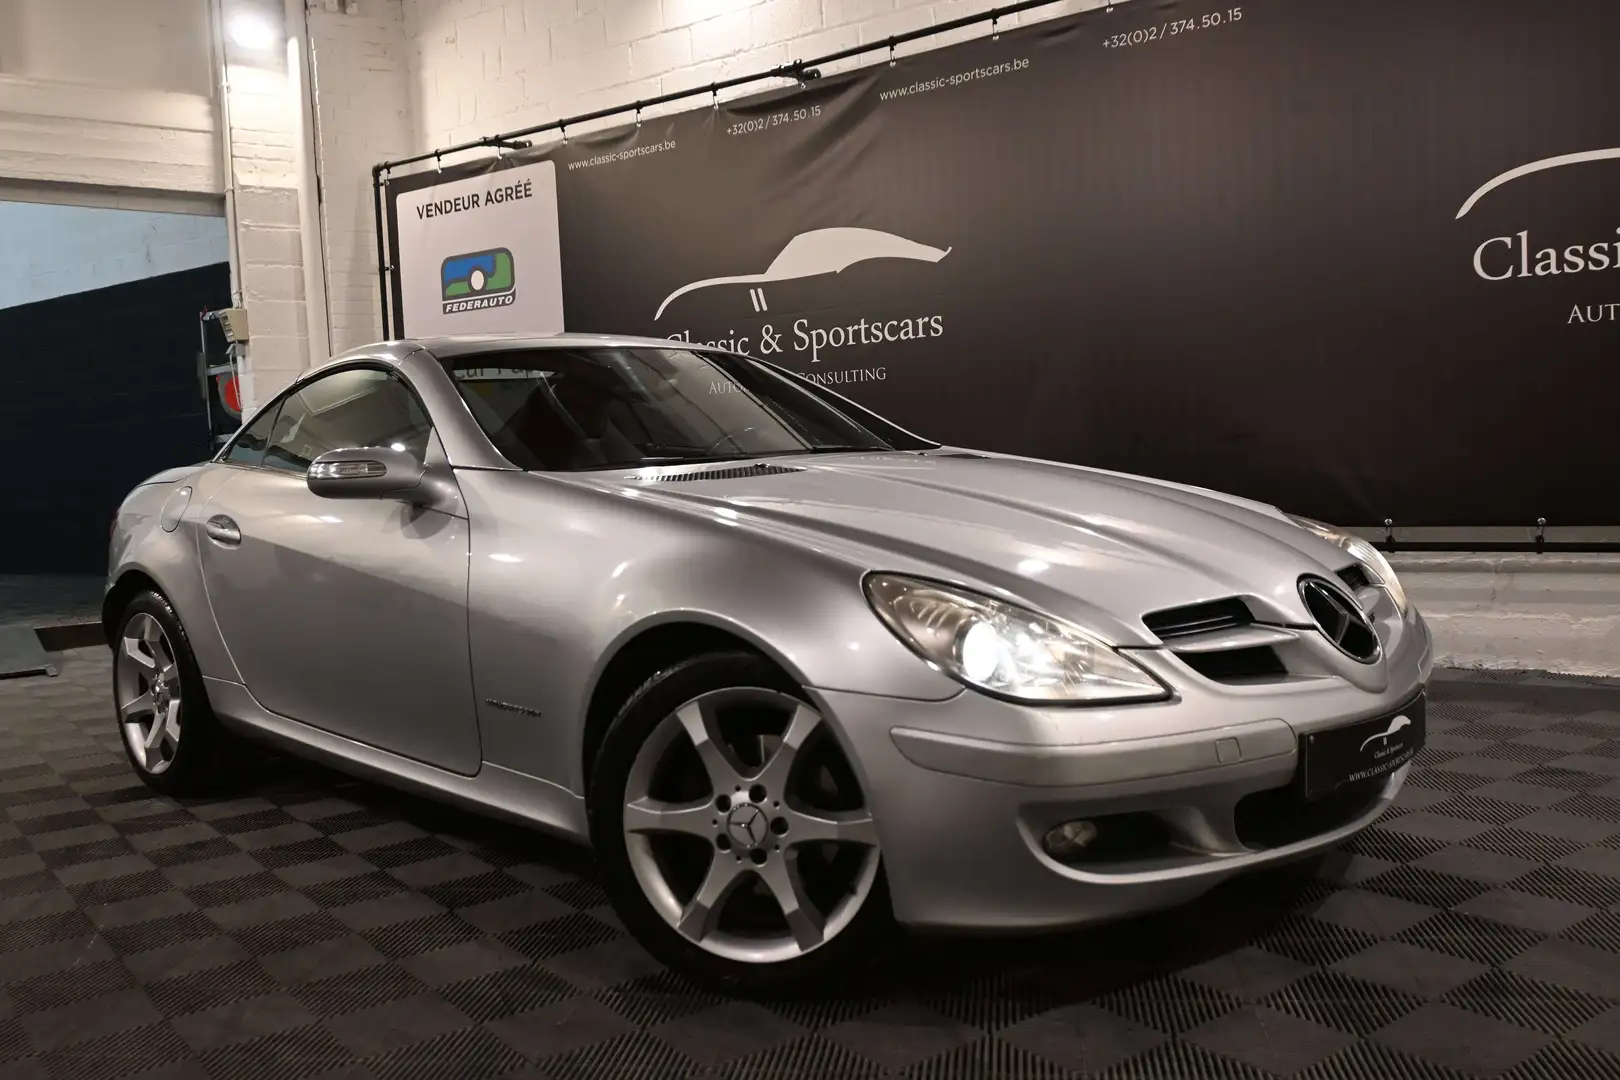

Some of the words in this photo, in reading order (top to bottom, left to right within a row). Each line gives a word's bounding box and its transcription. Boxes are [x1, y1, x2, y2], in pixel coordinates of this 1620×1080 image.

[1103, 26, 1157, 48] +32(0)2
[1170, 7, 1242, 35] 374.50.15
[880, 57, 1030, 101] www.classic-sportscars.be
[727, 118, 764, 135] +32(0)2
[772, 105, 821, 126] 374.50.15
[568, 139, 677, 171] www.classic-sportscars.be
[416, 193, 481, 220] VENDEUR
[484, 178, 533, 206] AGRÉÉ
[445, 295, 513, 313] FEDERAUTO
[760, 324, 784, 355] &
[793, 314, 944, 363] Sportscars
